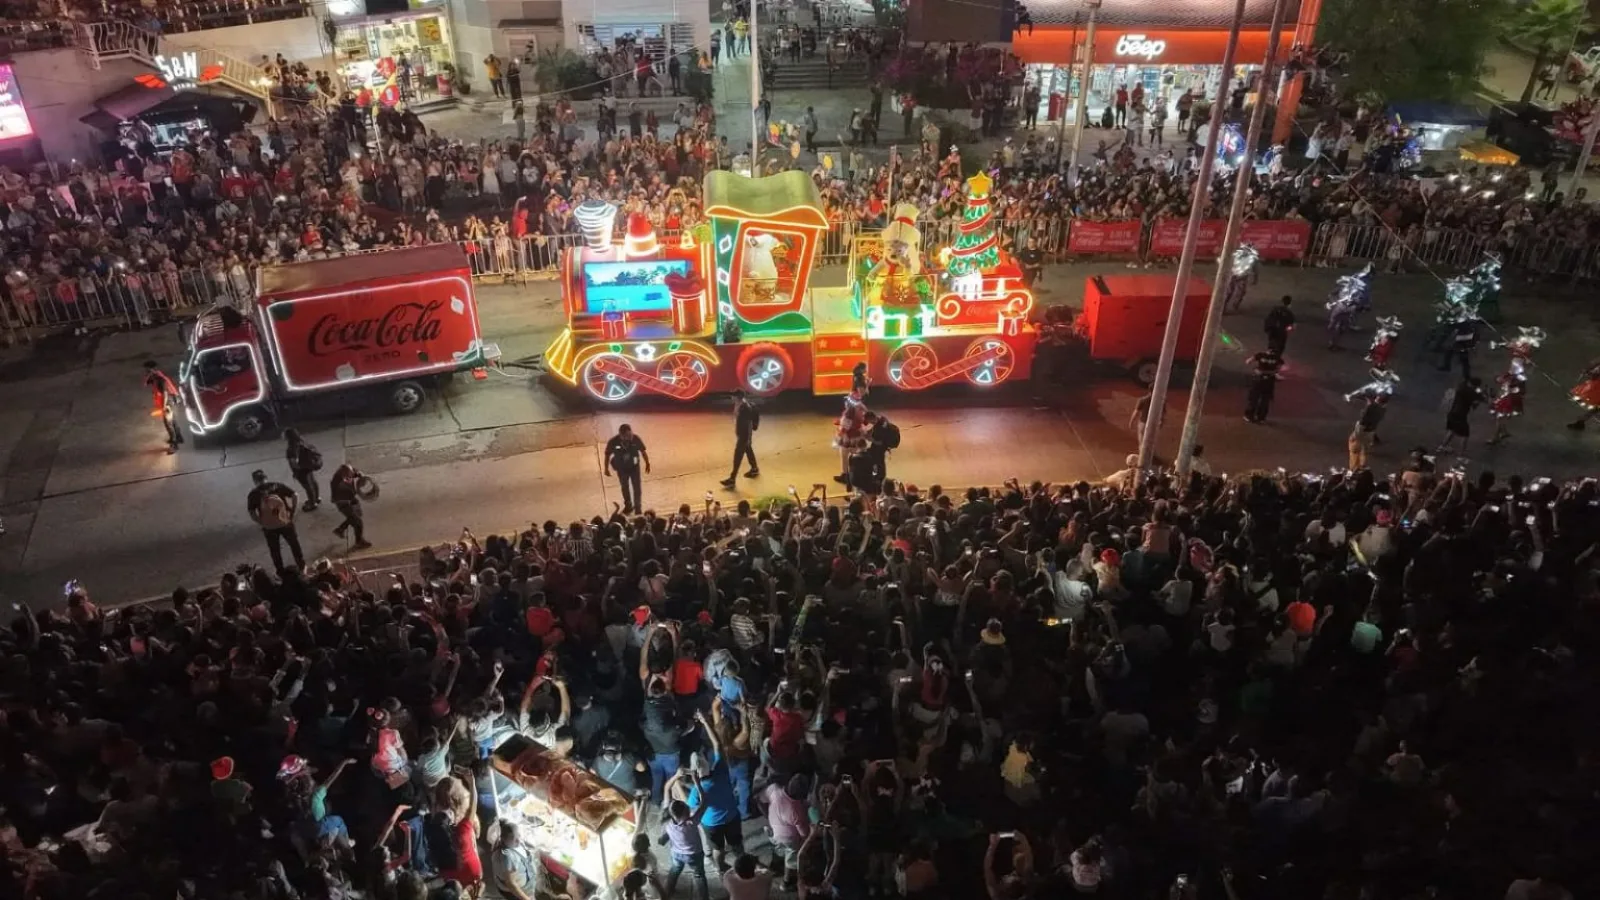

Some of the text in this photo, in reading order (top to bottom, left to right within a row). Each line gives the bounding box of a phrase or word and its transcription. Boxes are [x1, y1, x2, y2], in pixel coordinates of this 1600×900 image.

[1116, 34, 1166, 60] beep
[155, 52, 197, 81] S&W
[364, 350, 401, 363] ZERO
